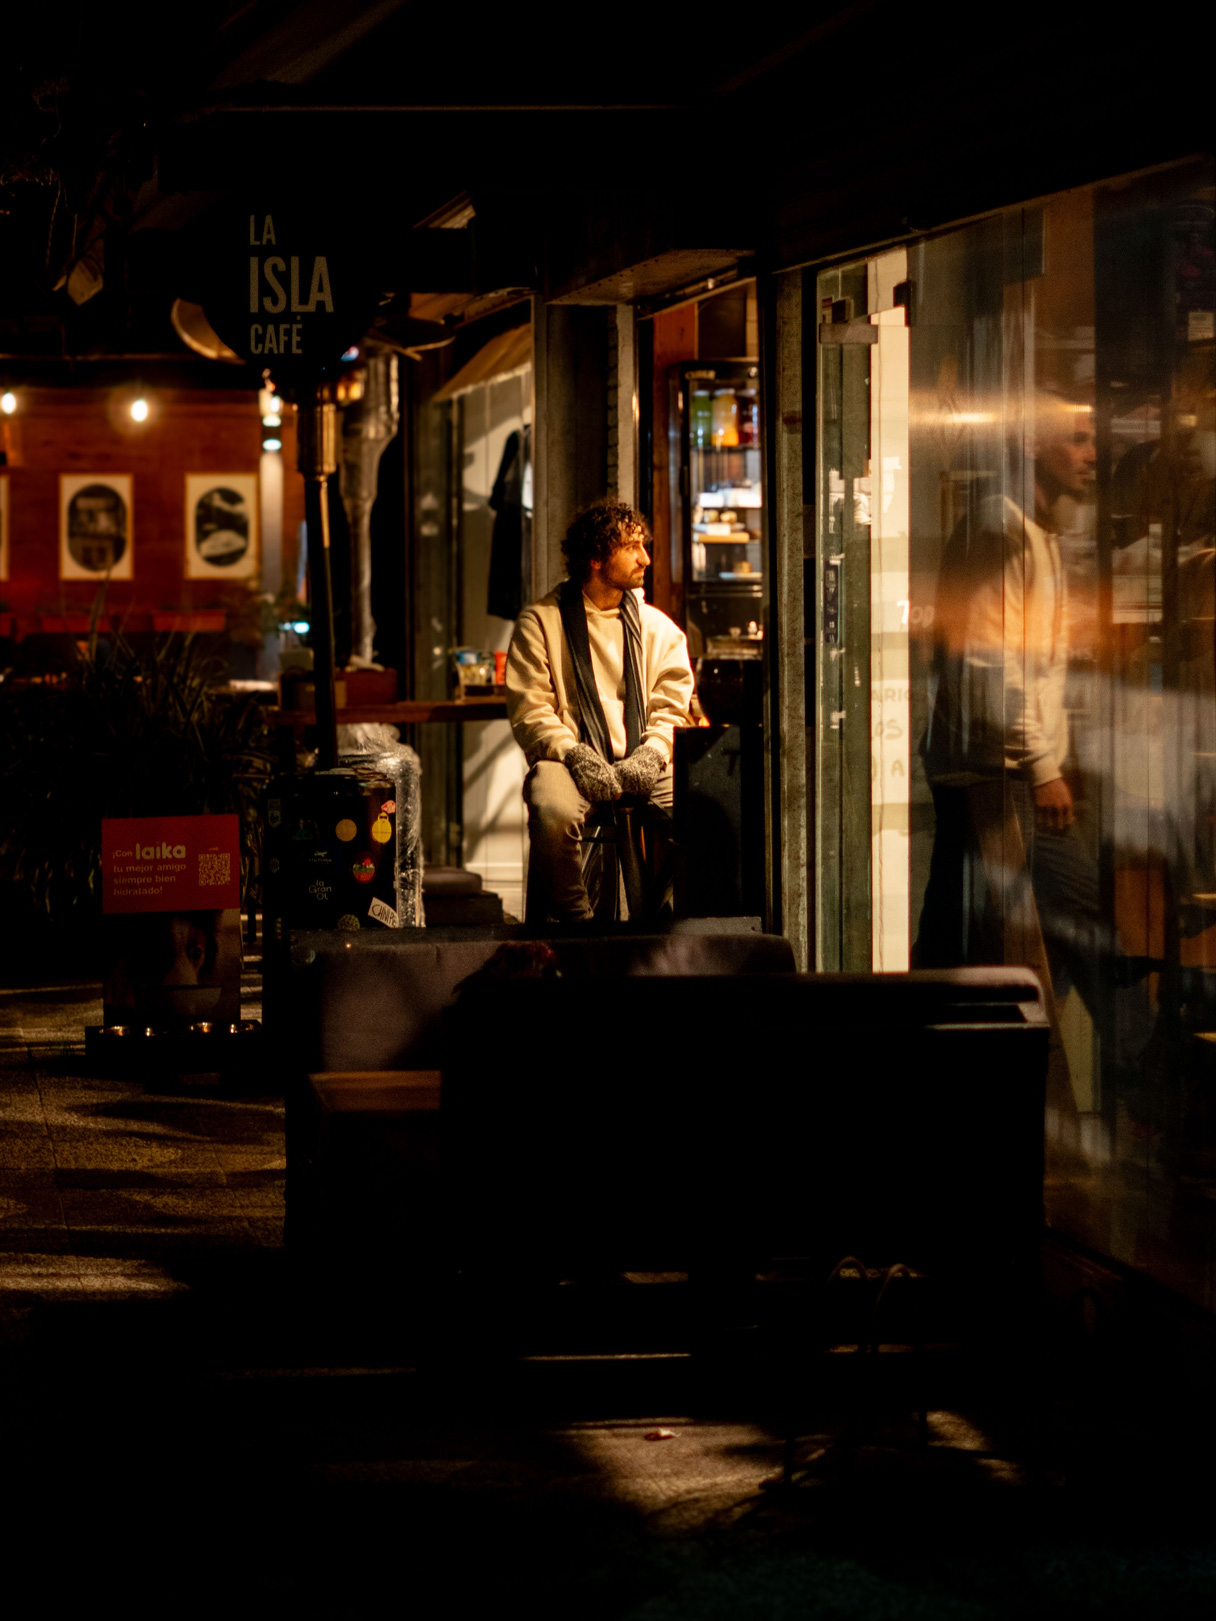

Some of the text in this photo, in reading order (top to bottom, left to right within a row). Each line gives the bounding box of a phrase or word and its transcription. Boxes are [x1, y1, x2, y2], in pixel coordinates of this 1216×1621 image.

[249, 213, 277, 246] LA
[249, 255, 335, 314] ISLA
[249, 314, 304, 355] CAFÉ
[135, 841, 187, 860] laika
[113, 862, 187, 874] tu mejor amigo
[113, 873, 176, 886] siempre bien
[113, 885, 164, 897] hidratado!
